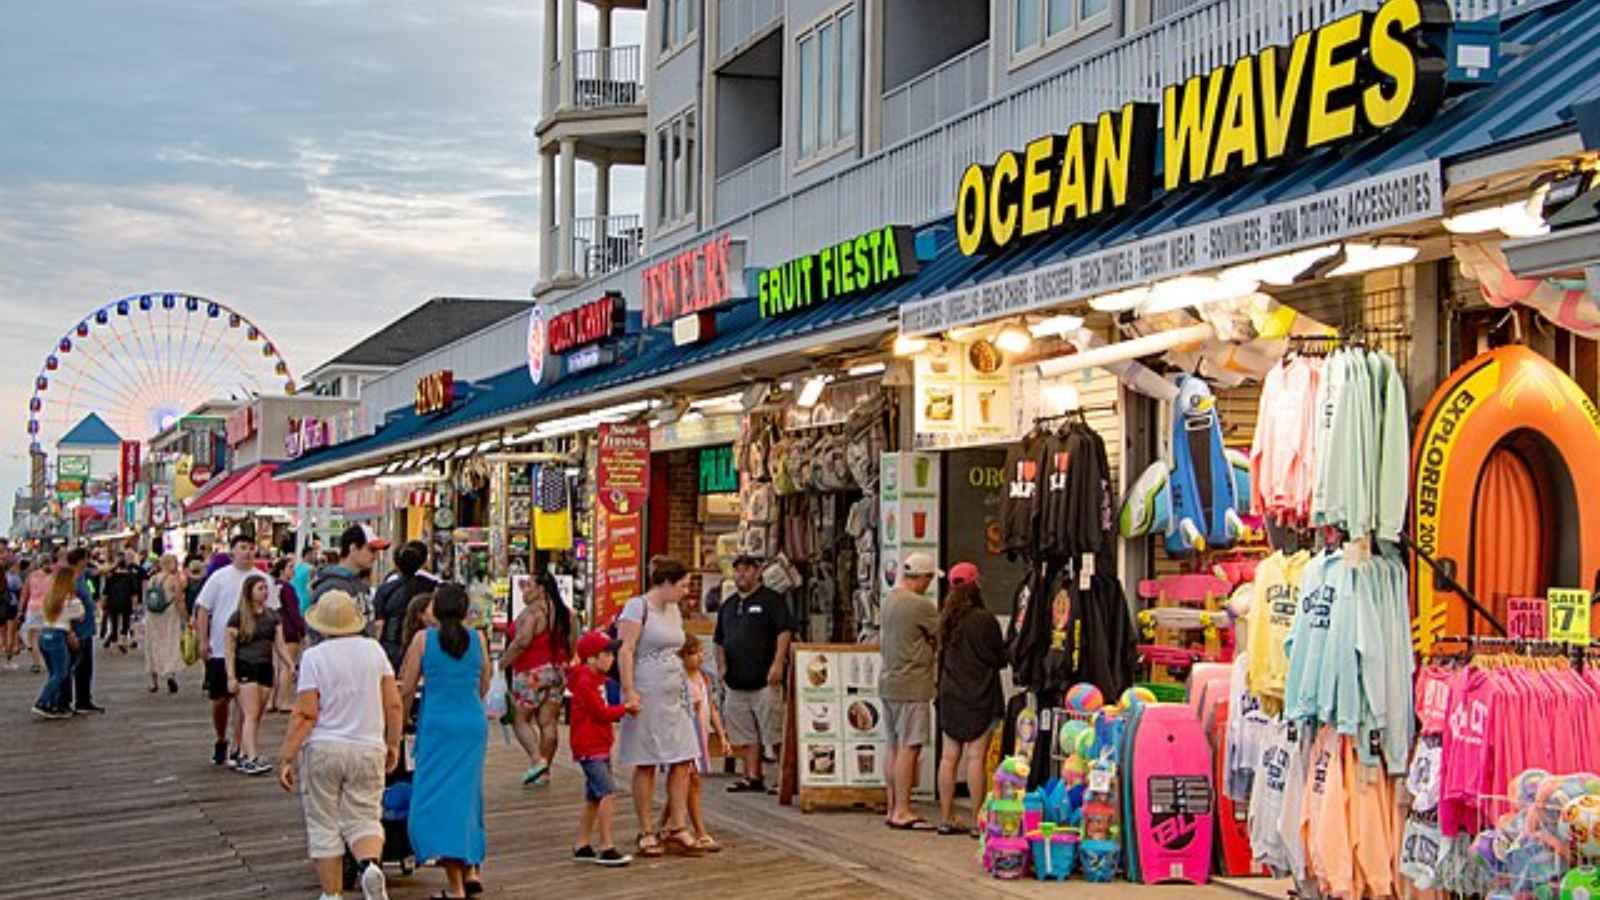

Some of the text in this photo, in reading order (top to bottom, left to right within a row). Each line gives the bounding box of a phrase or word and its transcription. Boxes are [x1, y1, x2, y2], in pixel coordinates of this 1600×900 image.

[955, 0, 1422, 257] OCEAN WAVES
[1170, 233, 1195, 268] WEAR
[1346, 171, 1432, 230] ACCESSORIES
[642, 233, 733, 329] JEWELRY
[758, 225, 900, 319] FRUIT FIESTA
[1419, 389, 1476, 519] EXPLORER
